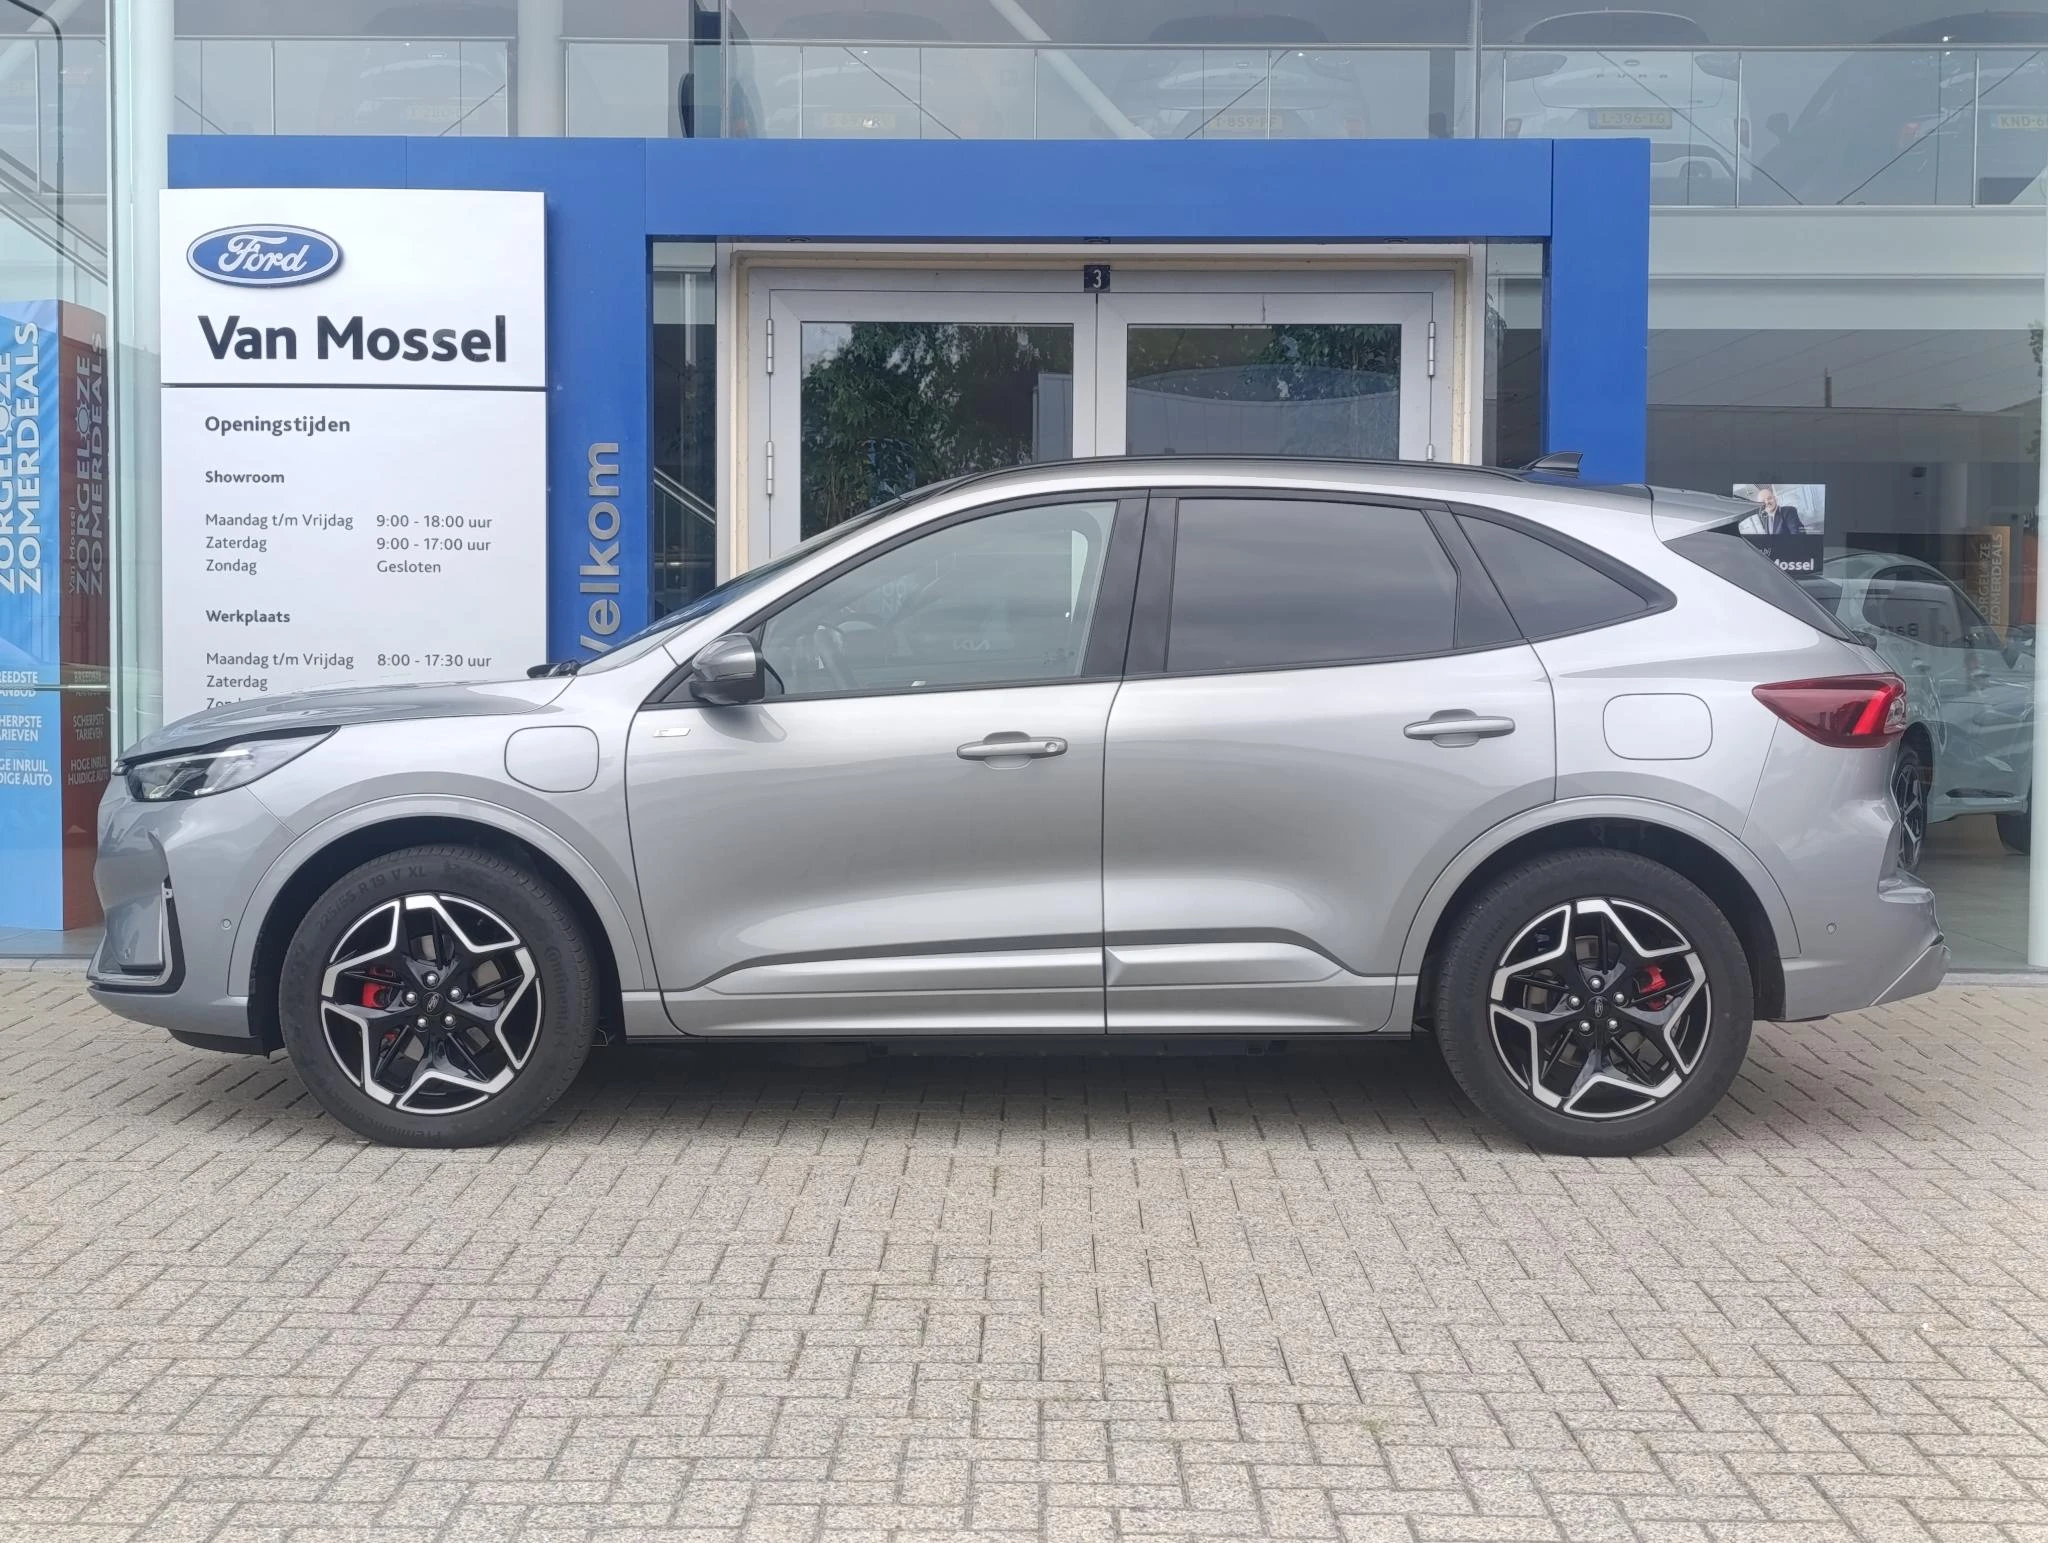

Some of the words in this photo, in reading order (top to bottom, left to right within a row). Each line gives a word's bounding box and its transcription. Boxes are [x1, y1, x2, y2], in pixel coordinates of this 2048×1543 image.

[1092, 269, 1102, 288] 3
[198, 315, 297, 360] Van
[317, 315, 507, 362] Mossel
[205, 416, 351, 436] Openingstijden
[15, 322, 41, 595] ZOMERDEALS
[91, 332, 103, 596] ZOMERDEALS
[205, 470, 285, 483] Showroom
[205, 513, 268, 529] Maandag
[272, 512, 298, 527] t/m
[302, 513, 354, 530] Vrijdag
[376, 514, 409, 528] 9:00
[424, 515, 464, 529] 18:00
[468, 517, 492, 528] uur
[206, 536, 267, 552] Zaterdag
[376, 537, 409, 550] 9:00
[424, 538, 463, 551] 17:00
[467, 540, 492, 551] uur
[206, 559, 257, 575] Zondag
[376, 560, 441, 573] Gesloten
[206, 610, 290, 626] Werkplaats
[206, 652, 269, 669] Maandag
[272, 652, 299, 666] t/m
[303, 652, 354, 670] Vrijdag
[377, 654, 410, 667] 8:00
[424, 654, 463, 668] 17:30
[467, 656, 492, 668] uur
[0, 671, 39, 684] EEDSTE
[206, 675, 268, 691] Zaterdag
[0, 728, 39, 742] RIEVEN
[13, 759, 49, 773] INRUIL
[22, 773, 53, 786] AUTO
